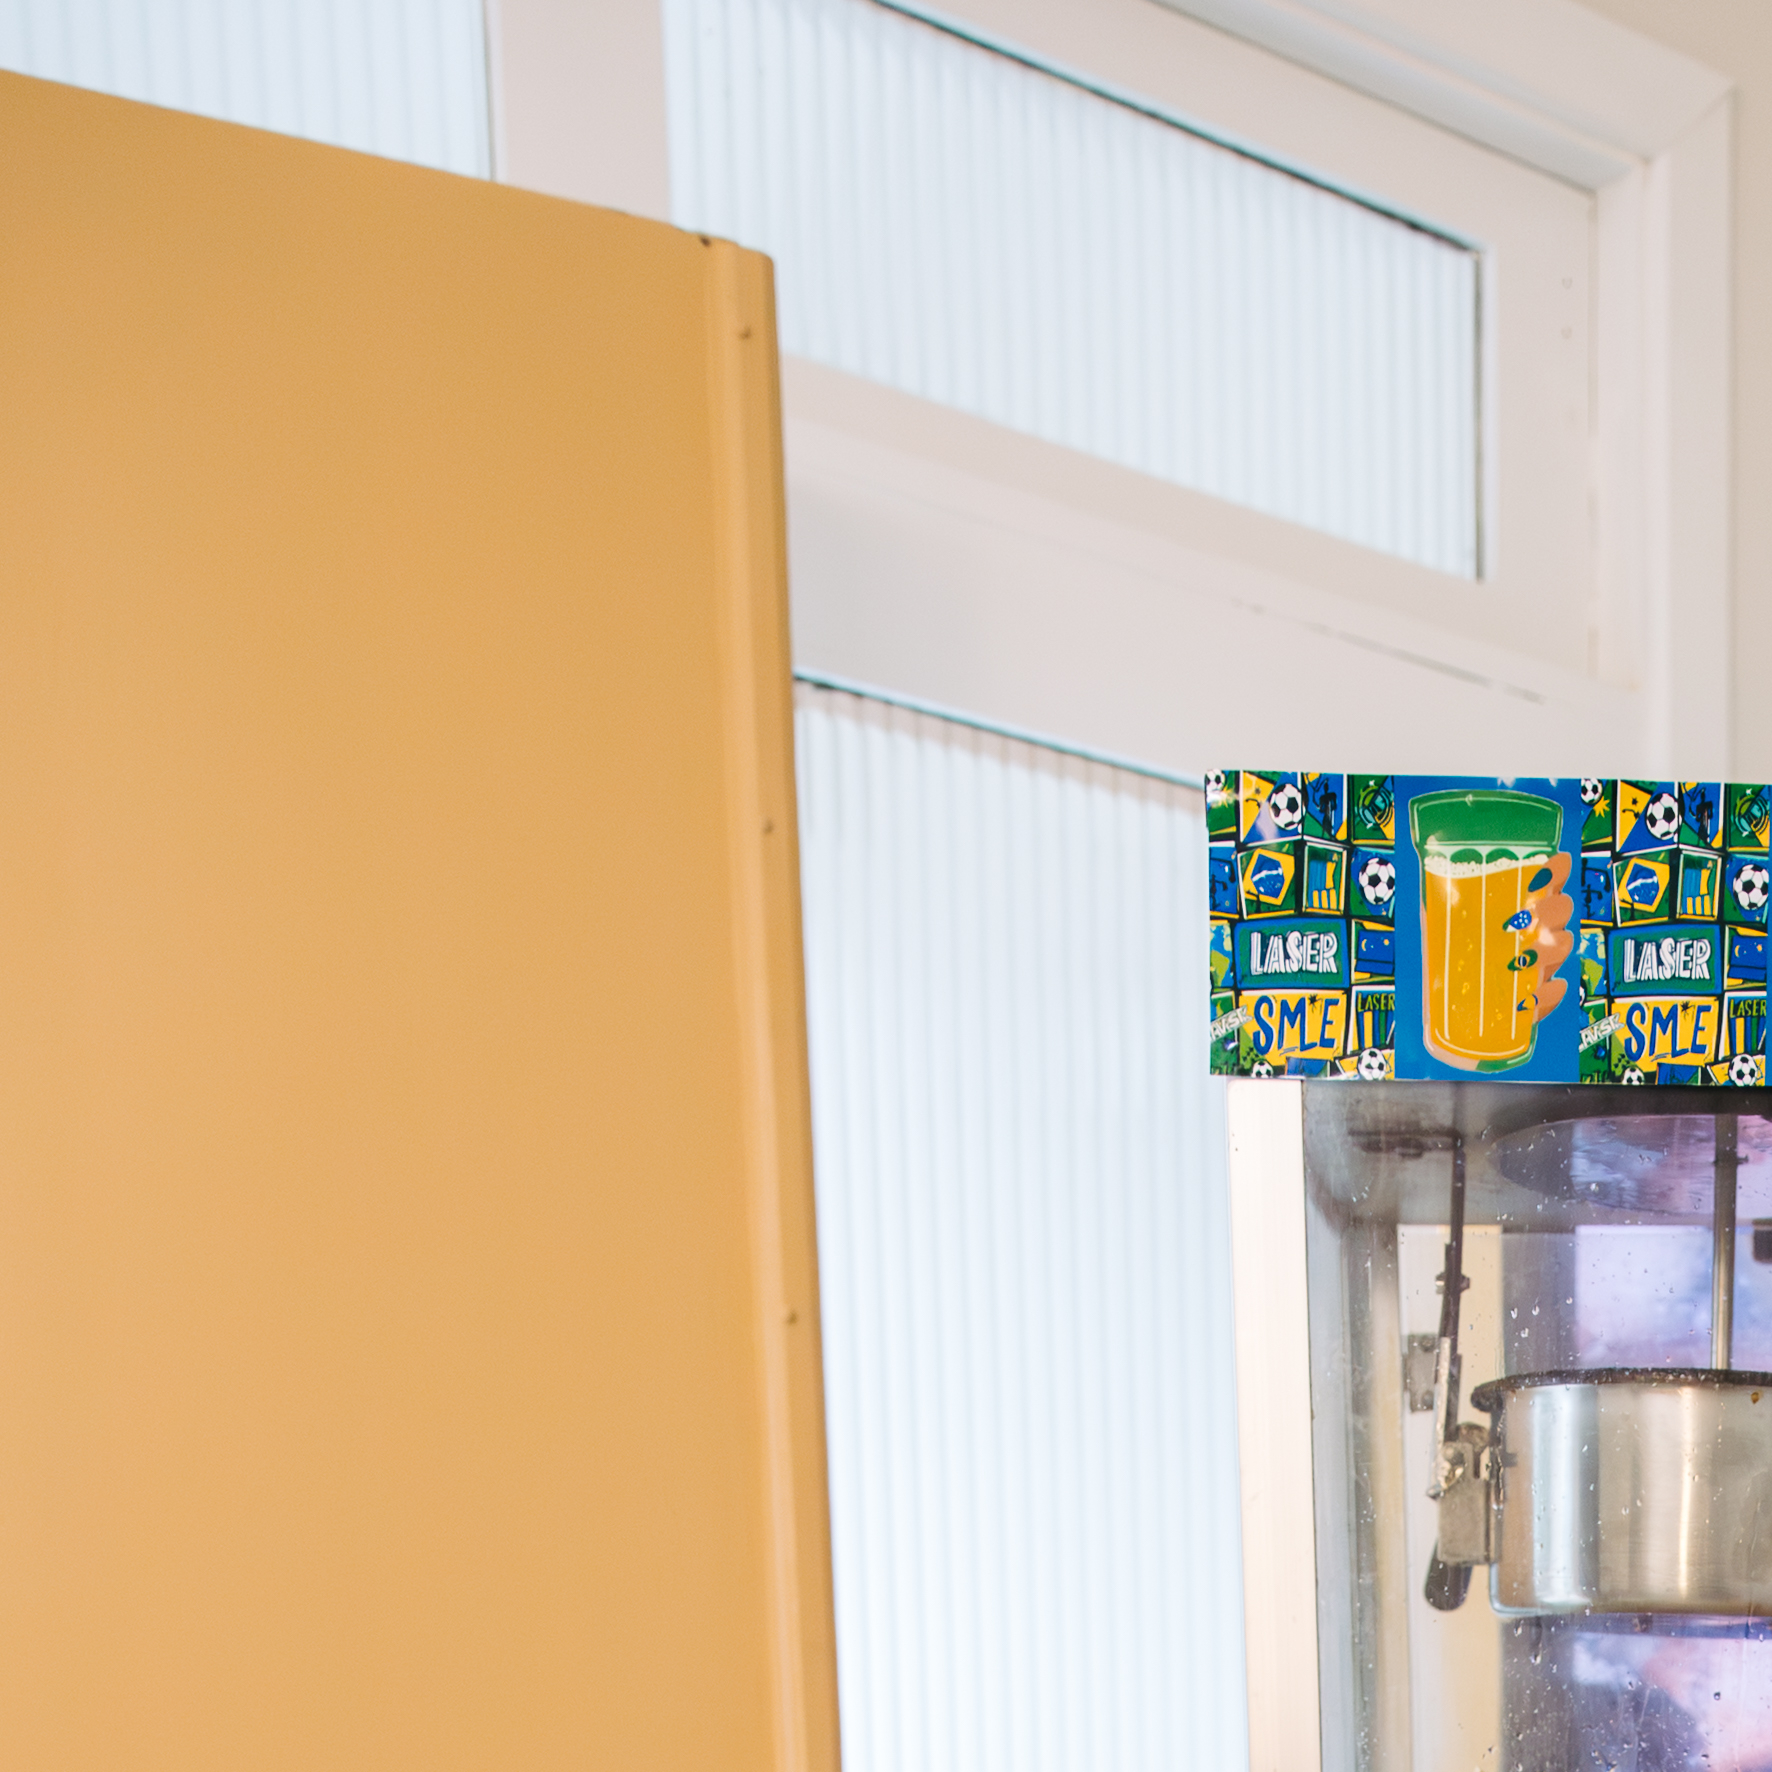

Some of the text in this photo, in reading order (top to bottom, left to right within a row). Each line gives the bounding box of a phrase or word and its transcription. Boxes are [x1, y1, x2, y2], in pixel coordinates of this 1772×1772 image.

[1251, 931, 1338, 975] LASER
[1624, 937, 1711, 982] LASER
[1357, 992, 1395, 1012] LASER
[1730, 999, 1767, 1018] LASER
